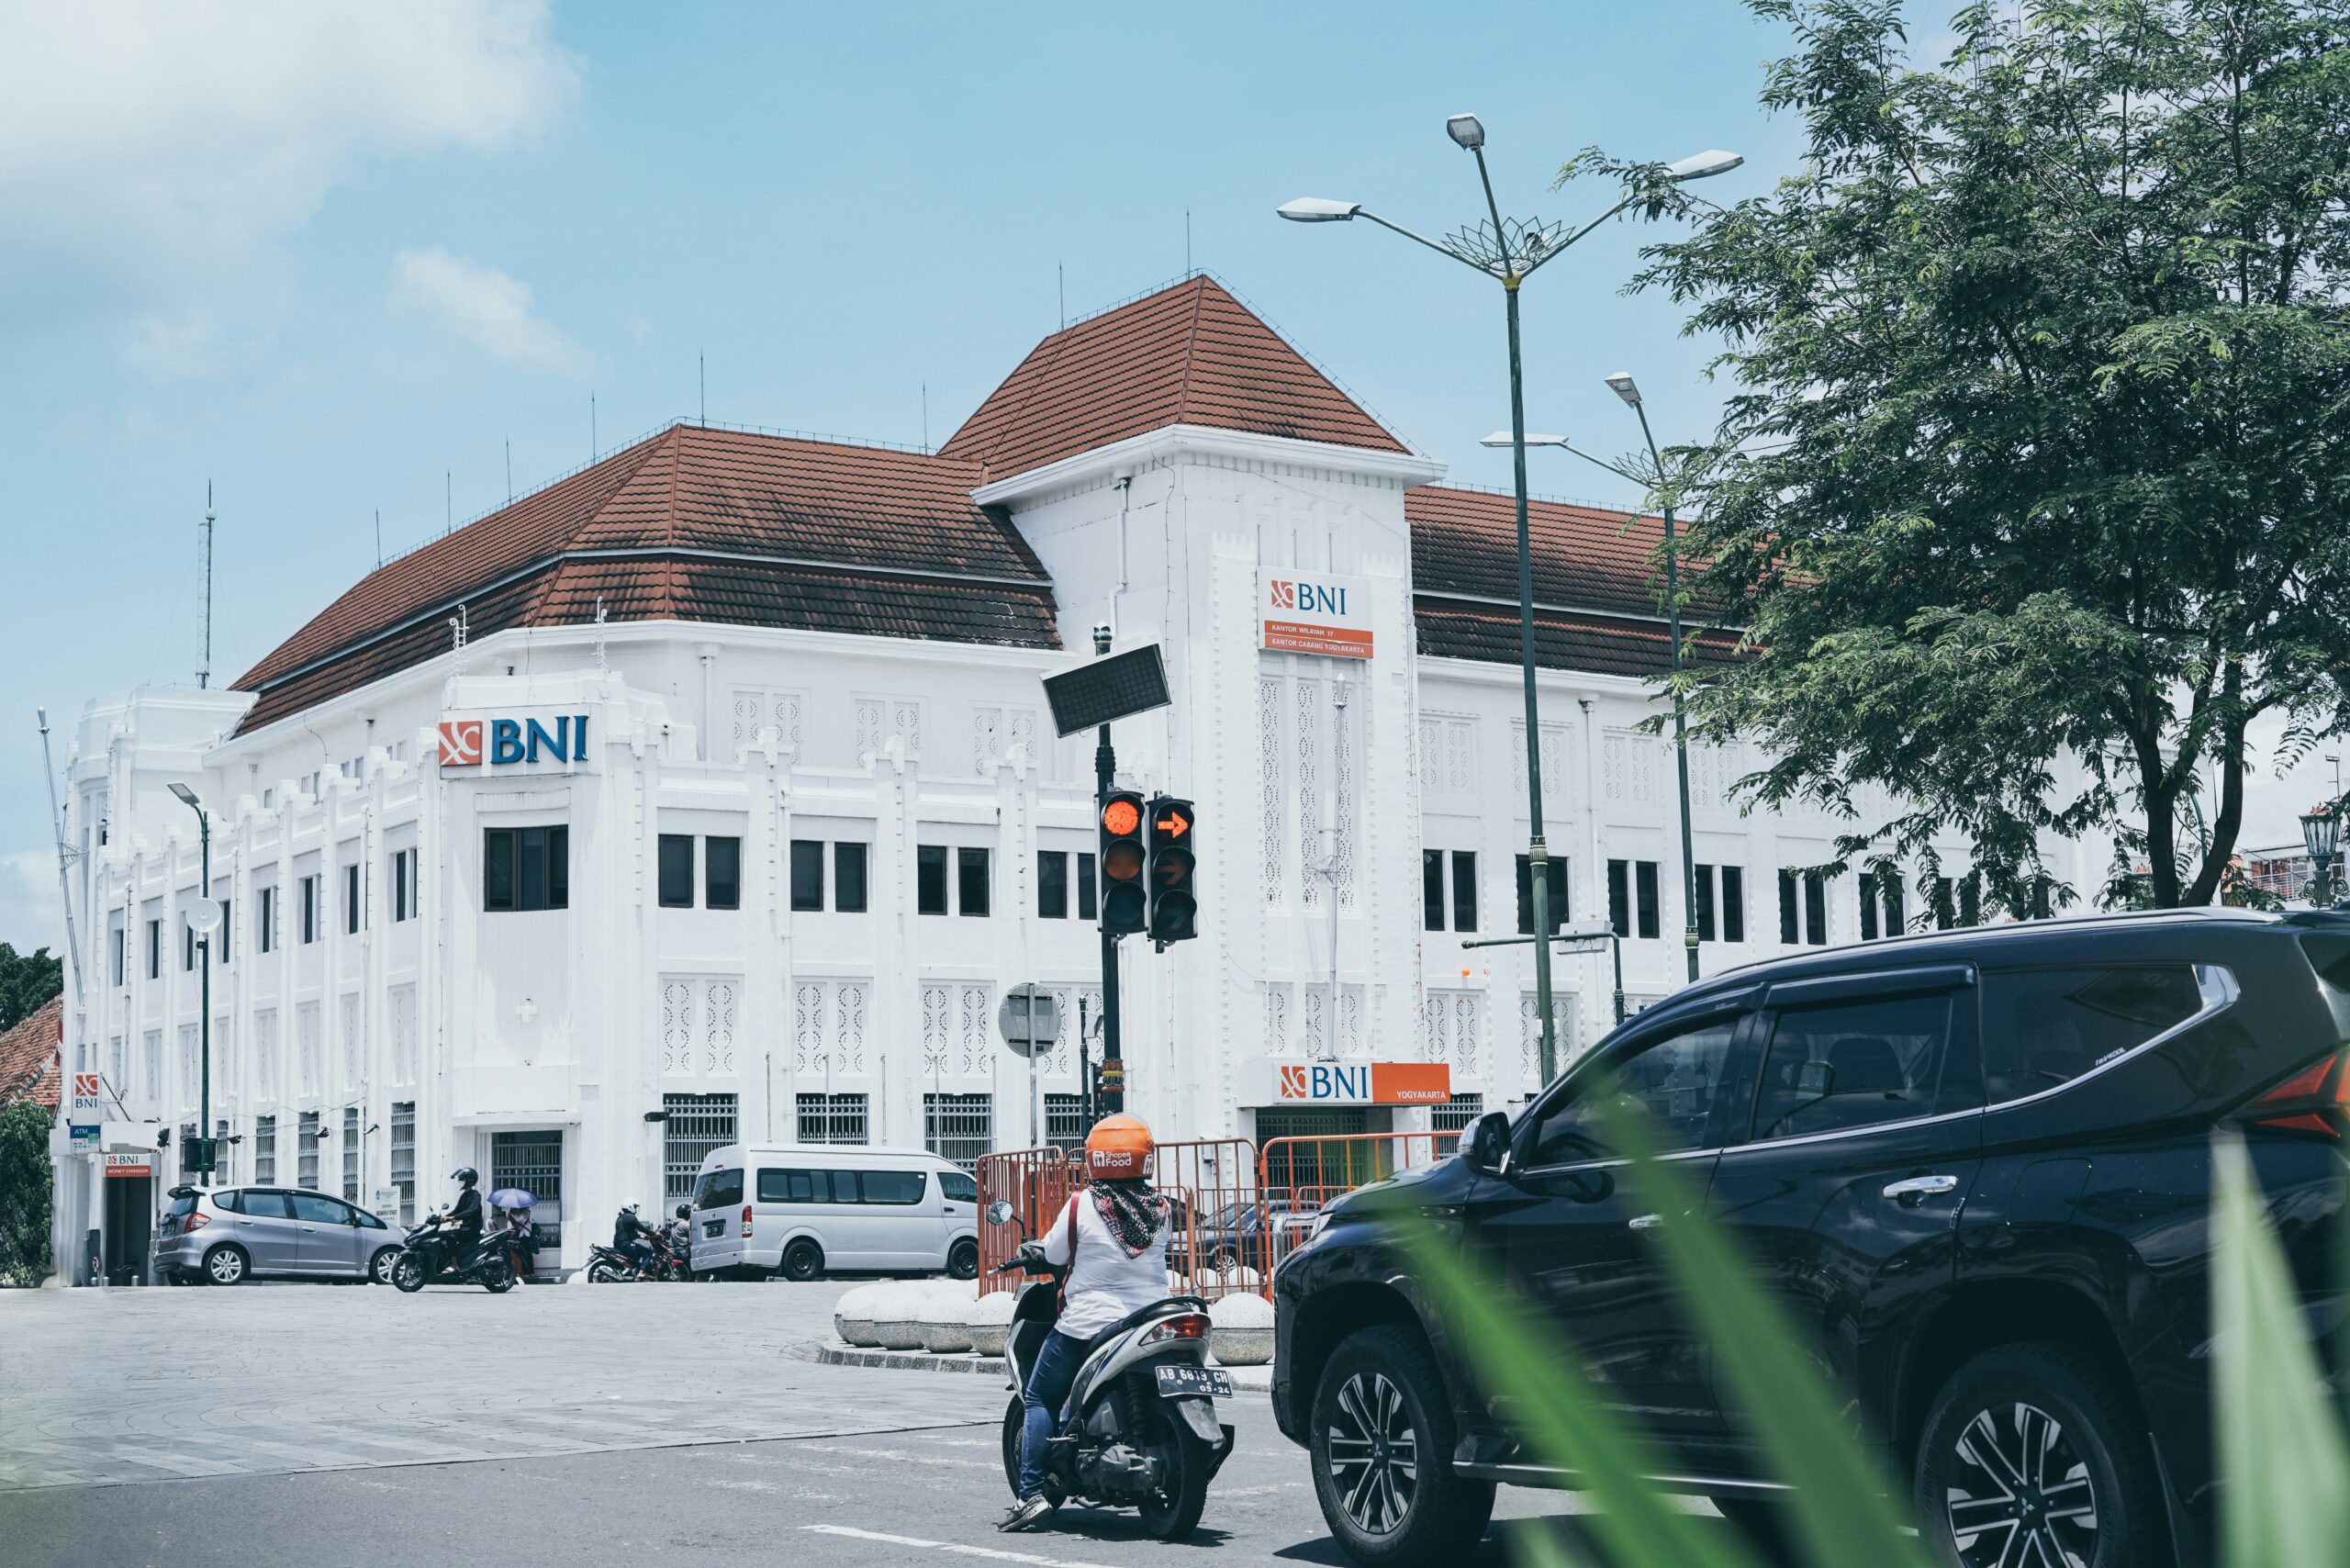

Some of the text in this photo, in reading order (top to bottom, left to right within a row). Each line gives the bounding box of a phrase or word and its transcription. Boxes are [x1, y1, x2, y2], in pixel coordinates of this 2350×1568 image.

[1298, 583, 1347, 615] BNI
[1271, 624, 1297, 633] KANTOR
[1299, 627, 1325, 635] WILAYAH
[1271, 638, 1365, 654] KANTOR CABANG YOGYAKARTA
[490, 715, 589, 765] BNI
[1311, 1066, 1369, 1099] BNI
[1396, 1091, 1446, 1100] YOGYAKARTA
[75, 1098, 97, 1109] BNI
[119, 1155, 139, 1164] BNI
[1105, 1150, 1131, 1159] Shopee
[1105, 1157, 1132, 1167] Food
[1159, 1369, 1175, 1380] AB
[1180, 1369, 1207, 1381] 6819
